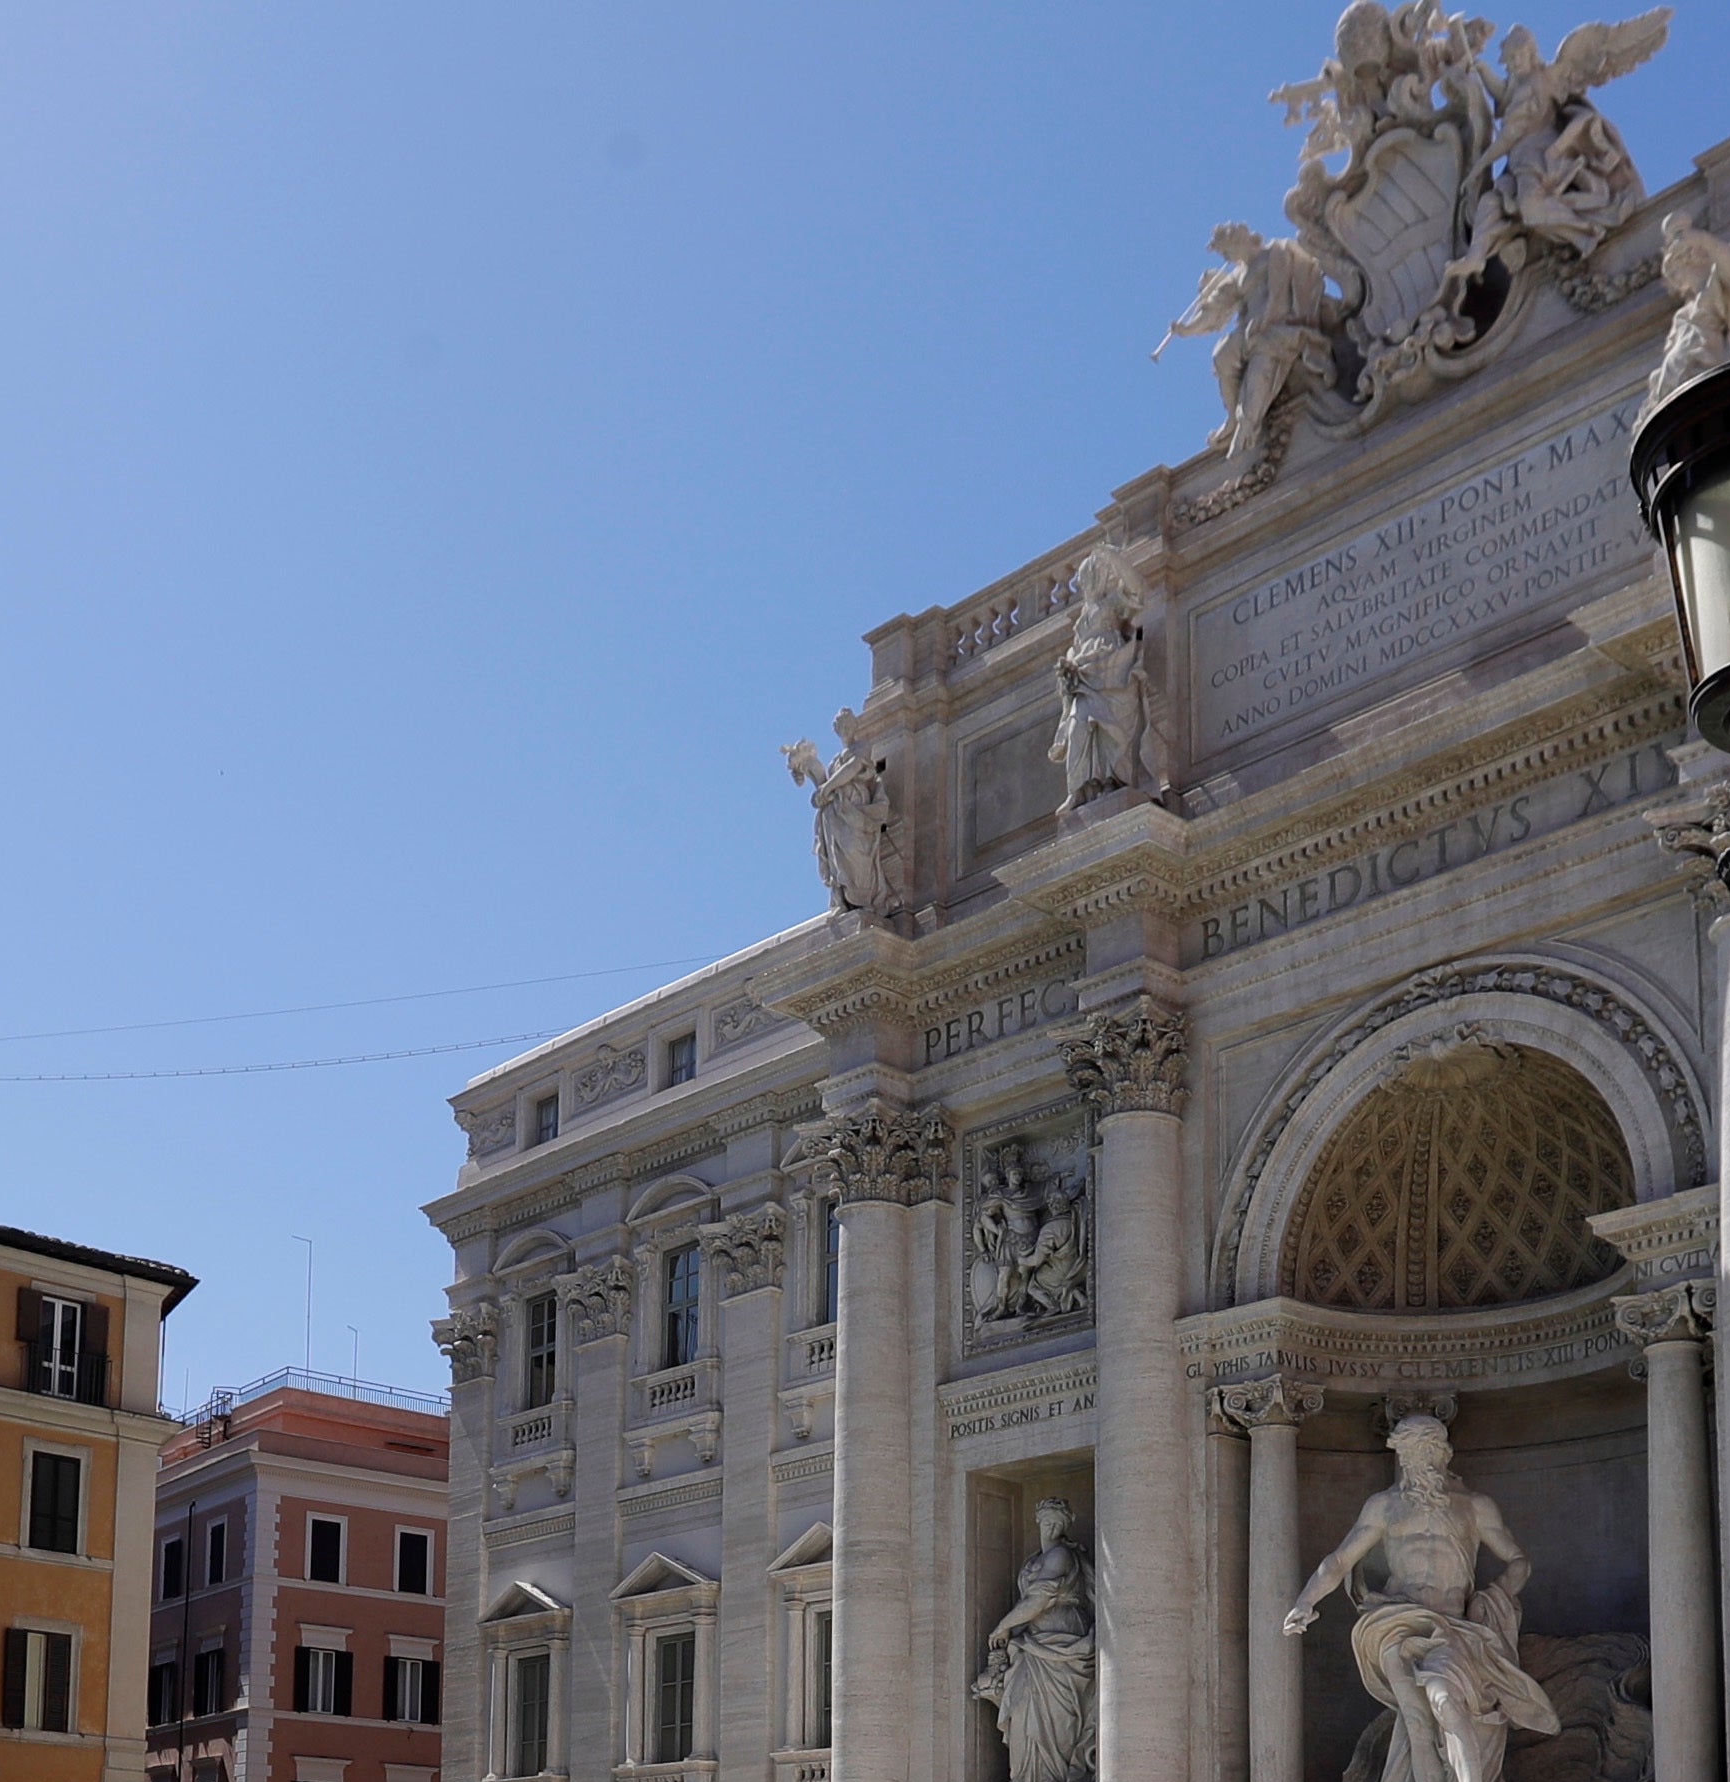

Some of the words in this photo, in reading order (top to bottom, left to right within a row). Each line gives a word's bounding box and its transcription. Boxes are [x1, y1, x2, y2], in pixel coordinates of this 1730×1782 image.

[1233, 545, 1358, 626] CLEMENS
[1262, 644, 1332, 690] CVLTV
[1344, 579, 1476, 654] MAGNIFICO
[1488, 515, 1601, 585] ORNAVIT
[1318, 559, 1399, 613] AQVAM
[1412, 491, 1532, 563] VIRGINEM
[1211, 650, 1270, 689] COPIA
[1280, 632, 1304, 658] ET
[1311, 561, 1453, 642] SALVBRITATE
[1220, 697, 1281, 738] ANNO
[1289, 655, 1369, 706] DOMINI
[1201, 795, 1531, 960] BENEDICTVS
[1256, 1349, 1317, 1372] TABVLIS
[1329, 1360, 1382, 1376] IVSSV
[951, 1415, 996, 1439] POSITIS
[1000, 1405, 1041, 1429] SIGNIS
[1048, 1399, 1064, 1417] ET
